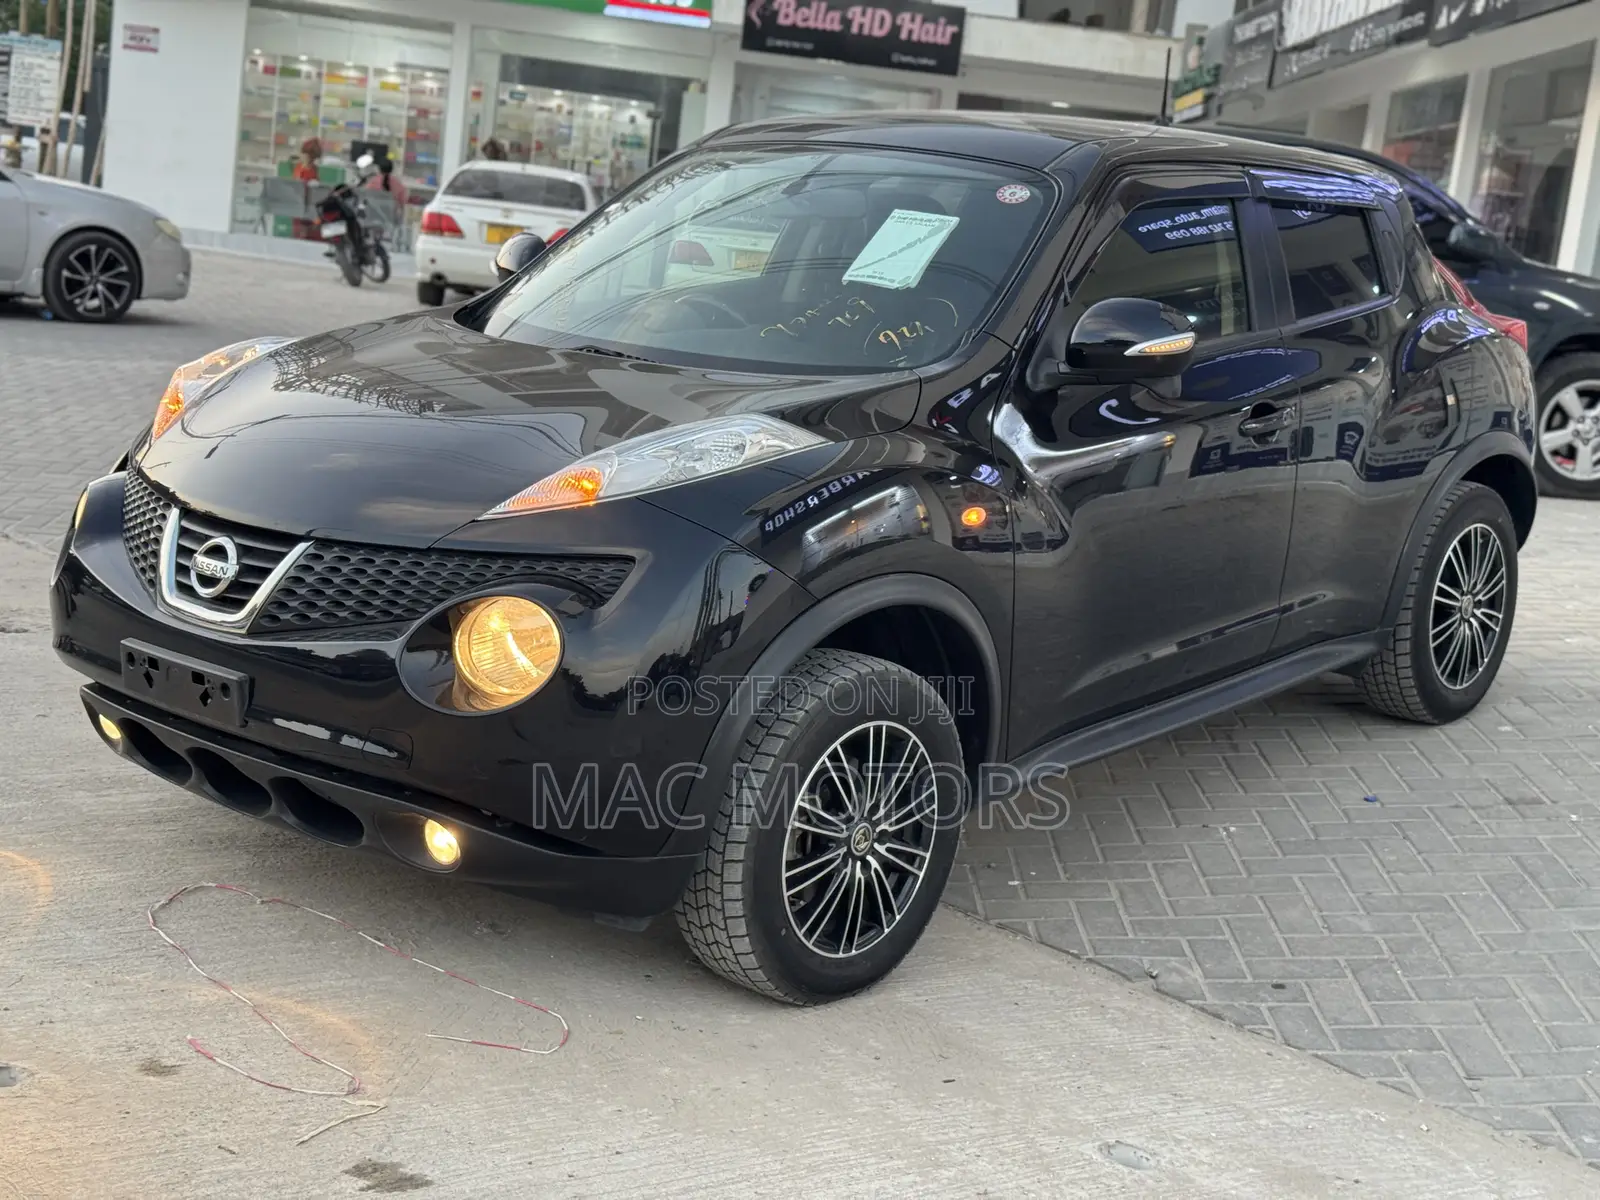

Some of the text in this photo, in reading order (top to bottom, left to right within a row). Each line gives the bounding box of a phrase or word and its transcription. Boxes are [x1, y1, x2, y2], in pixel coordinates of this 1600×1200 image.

[772, 0, 959, 45] Bella HD Hair
